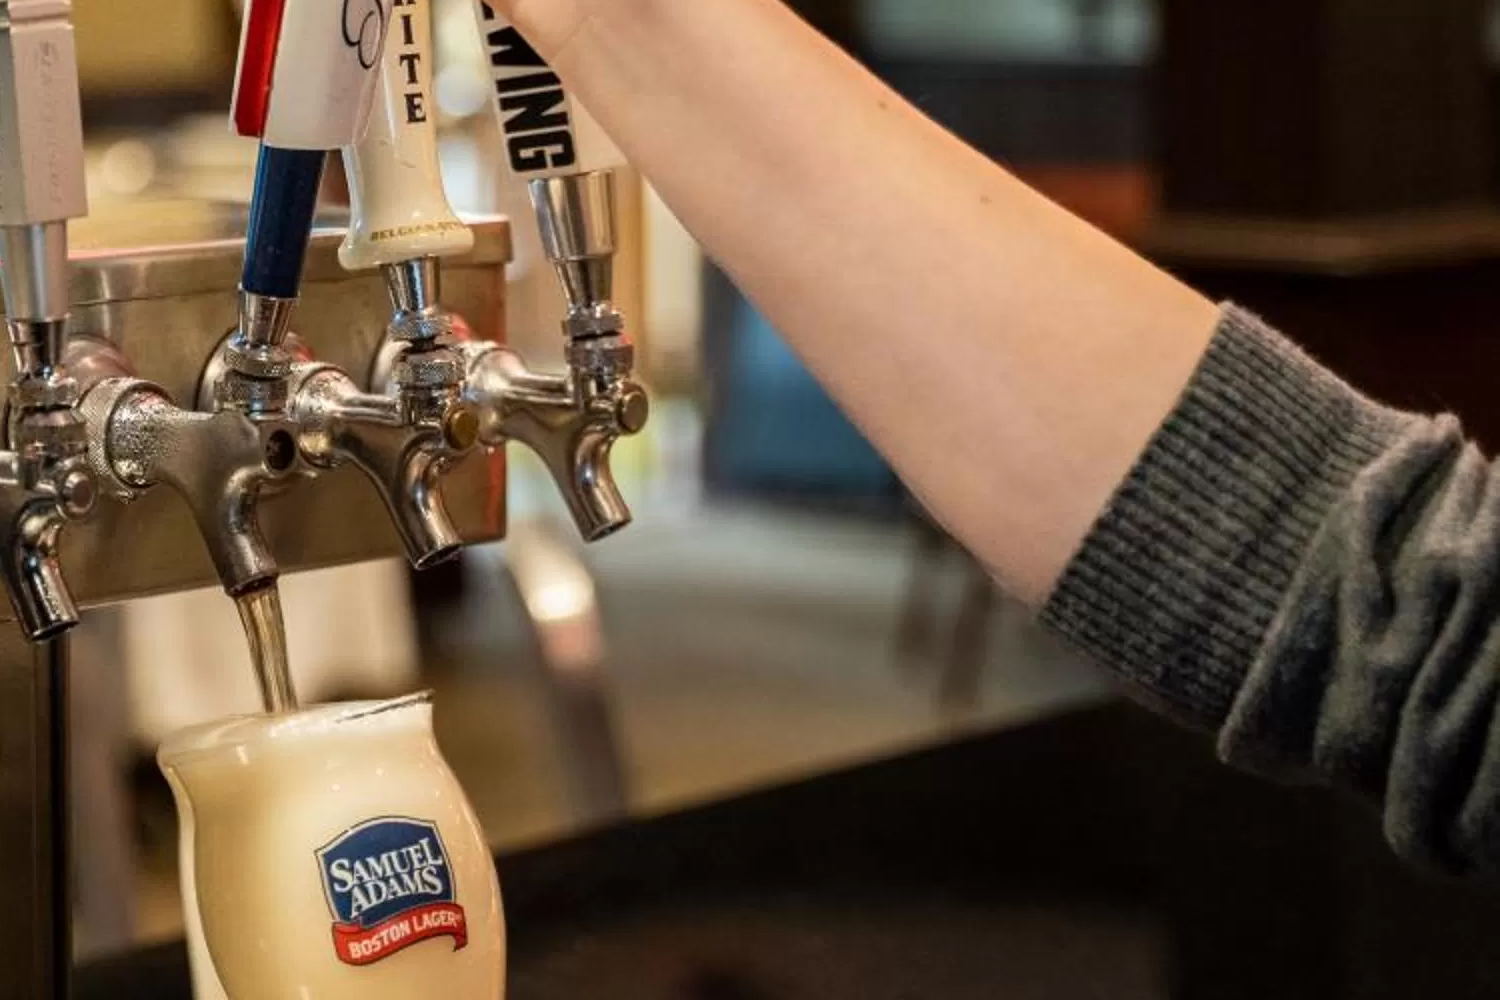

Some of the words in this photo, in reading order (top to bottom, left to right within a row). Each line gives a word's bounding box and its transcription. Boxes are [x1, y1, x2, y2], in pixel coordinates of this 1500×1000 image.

[481, 0, 576, 173] WING
[330, 837, 443, 893] SAMUEL
[349, 866, 443, 919] ADAMS
[348, 921, 411, 959] BOSTON
[413, 910, 459, 932] LAGER
